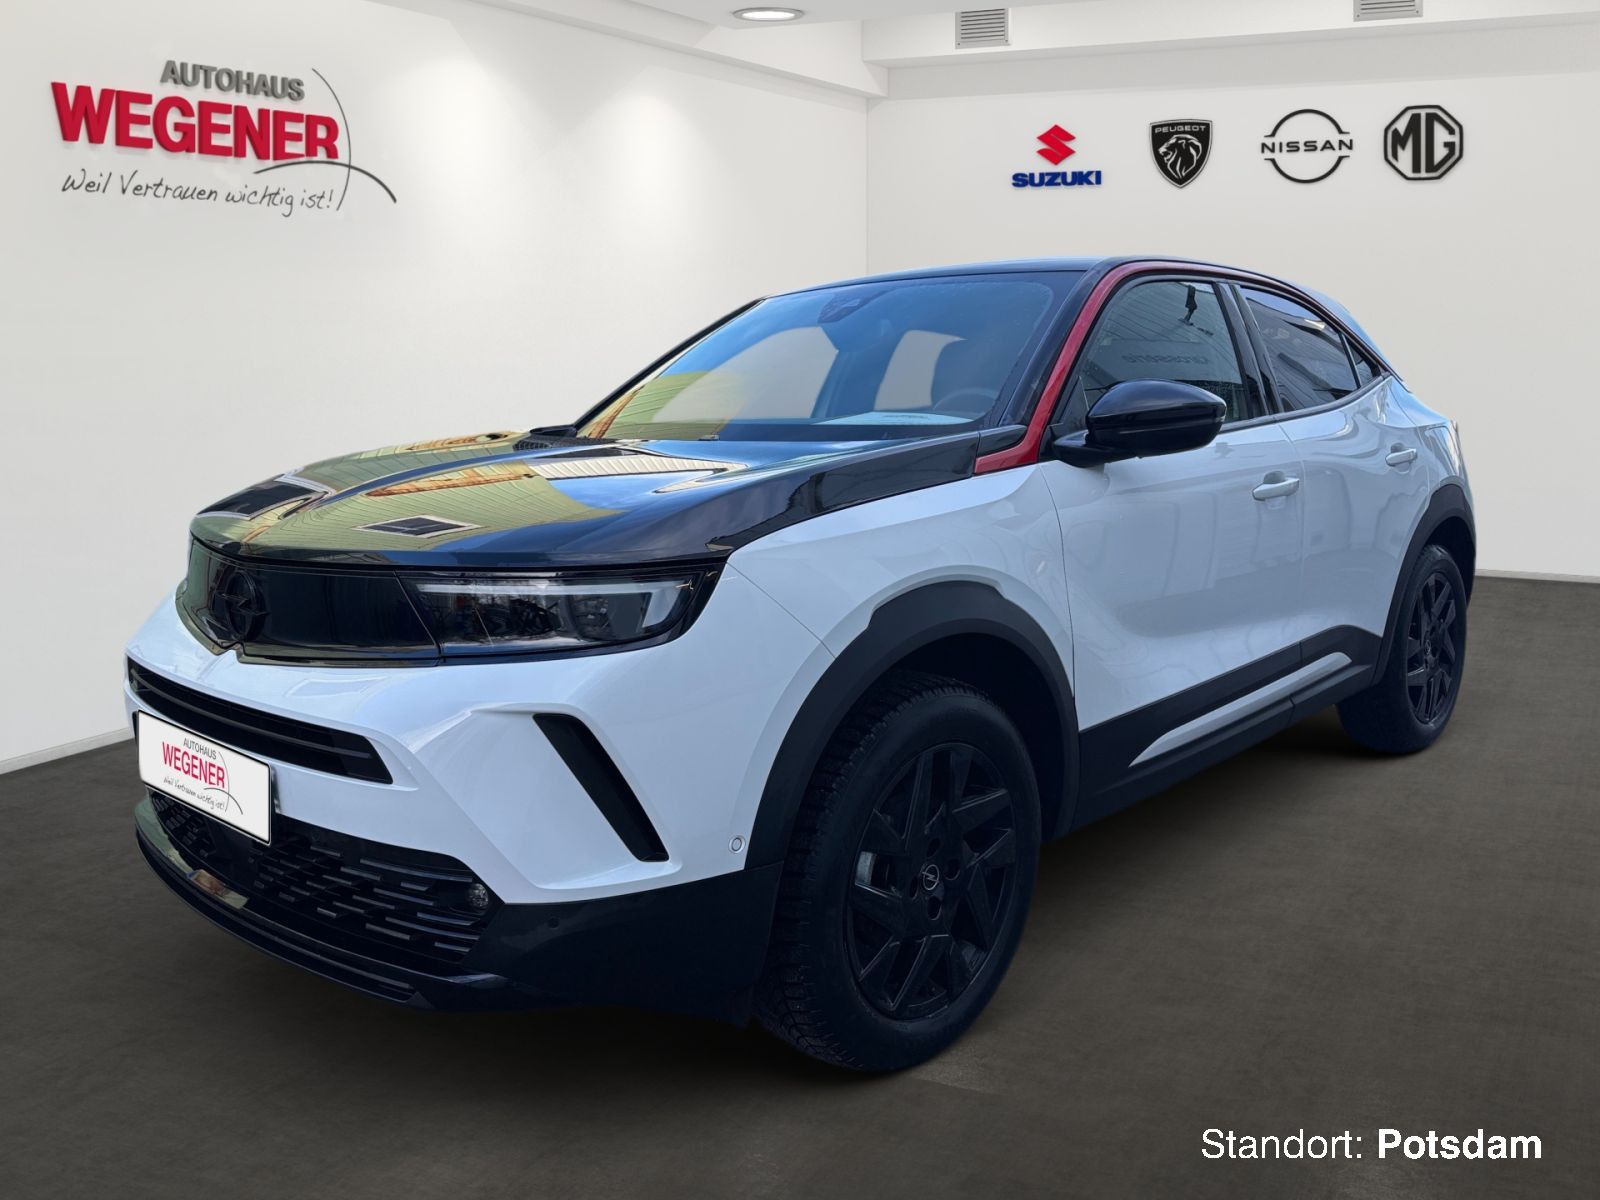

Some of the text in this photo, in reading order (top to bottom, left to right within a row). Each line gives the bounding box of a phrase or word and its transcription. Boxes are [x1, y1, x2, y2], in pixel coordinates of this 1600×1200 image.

[160, 60, 305, 101] AUTOHAUS
[51, 82, 340, 161] WEGENER
[1154, 125, 1207, 134] PEUGEOT
[1261, 139, 1353, 154] NISSAN
[1391, 112, 1456, 174] MG
[61, 168, 334, 218] Weil Vertrauen wichtig ist!
[1011, 170, 1102, 188] SUZUKI
[162, 741, 226, 789] WEGENER
[183, 738, 217, 760] AUTOHAUS
